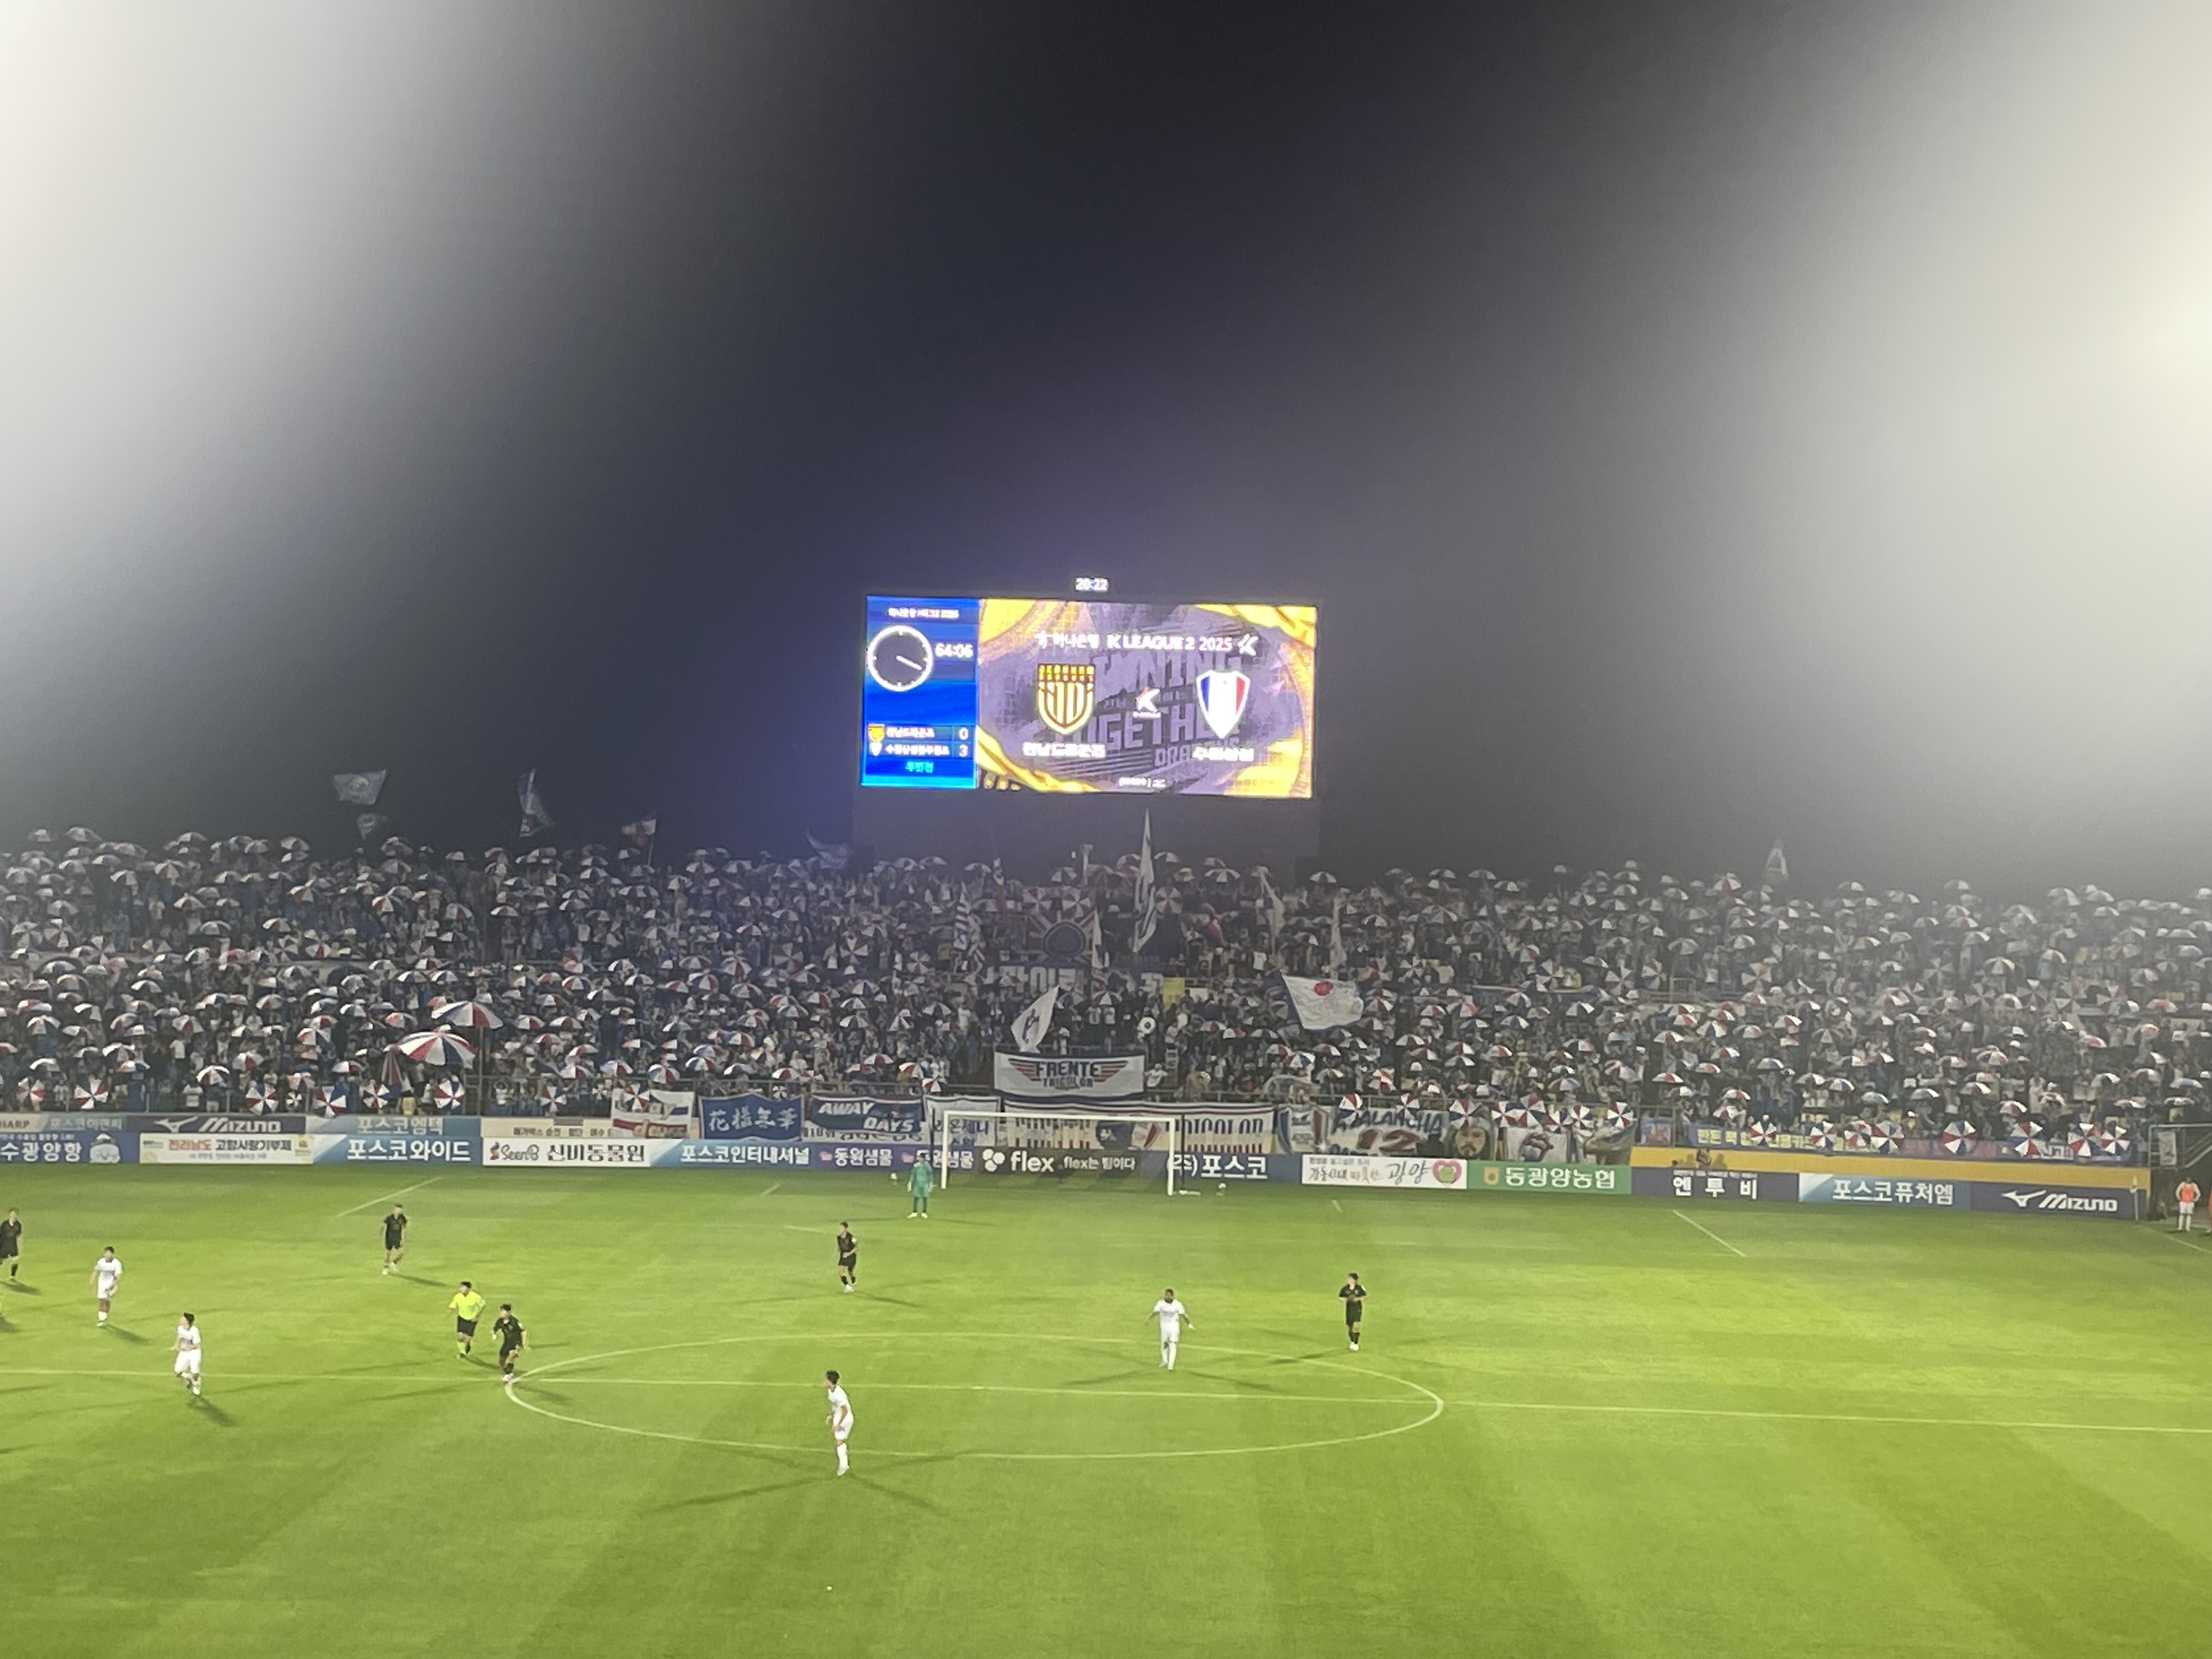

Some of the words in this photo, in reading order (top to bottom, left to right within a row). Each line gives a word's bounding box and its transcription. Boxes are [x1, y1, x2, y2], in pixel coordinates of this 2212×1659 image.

[1123, 635, 1184, 650] LEAGUE
[1199, 637, 1232, 651] 2025
[959, 727, 968, 740] 0
[959, 745, 968, 757] 3
[1035, 1061, 1099, 1077] FRENTE
[1042, 1076, 1093, 1088] TRICOLOR
[818, 1102, 875, 1115] AWAY
[863, 1116, 915, 1132] DAYS
[1, 1142, 82, 1162] 수광양항
[169, 1139, 212, 1151] 전라남도
[347, 1139, 471, 1161] 포스코와이드
[548, 1144, 645, 1162] 신비동물원
[681, 1144, 809, 1165] 포스코인터내셔널
[834, 1148, 893, 1166] 동원샘물
[1011, 1150, 1054, 1172] flex
[1063, 1156, 1099, 1170] flex는
[1102, 1157, 1136, 1170] 팀이다
[1385, 1160, 1432, 1186] 광양
[1505, 1167, 1615, 1189] 동광양농협
[1832, 1178, 1954, 1206] 포스코퓨처엠
